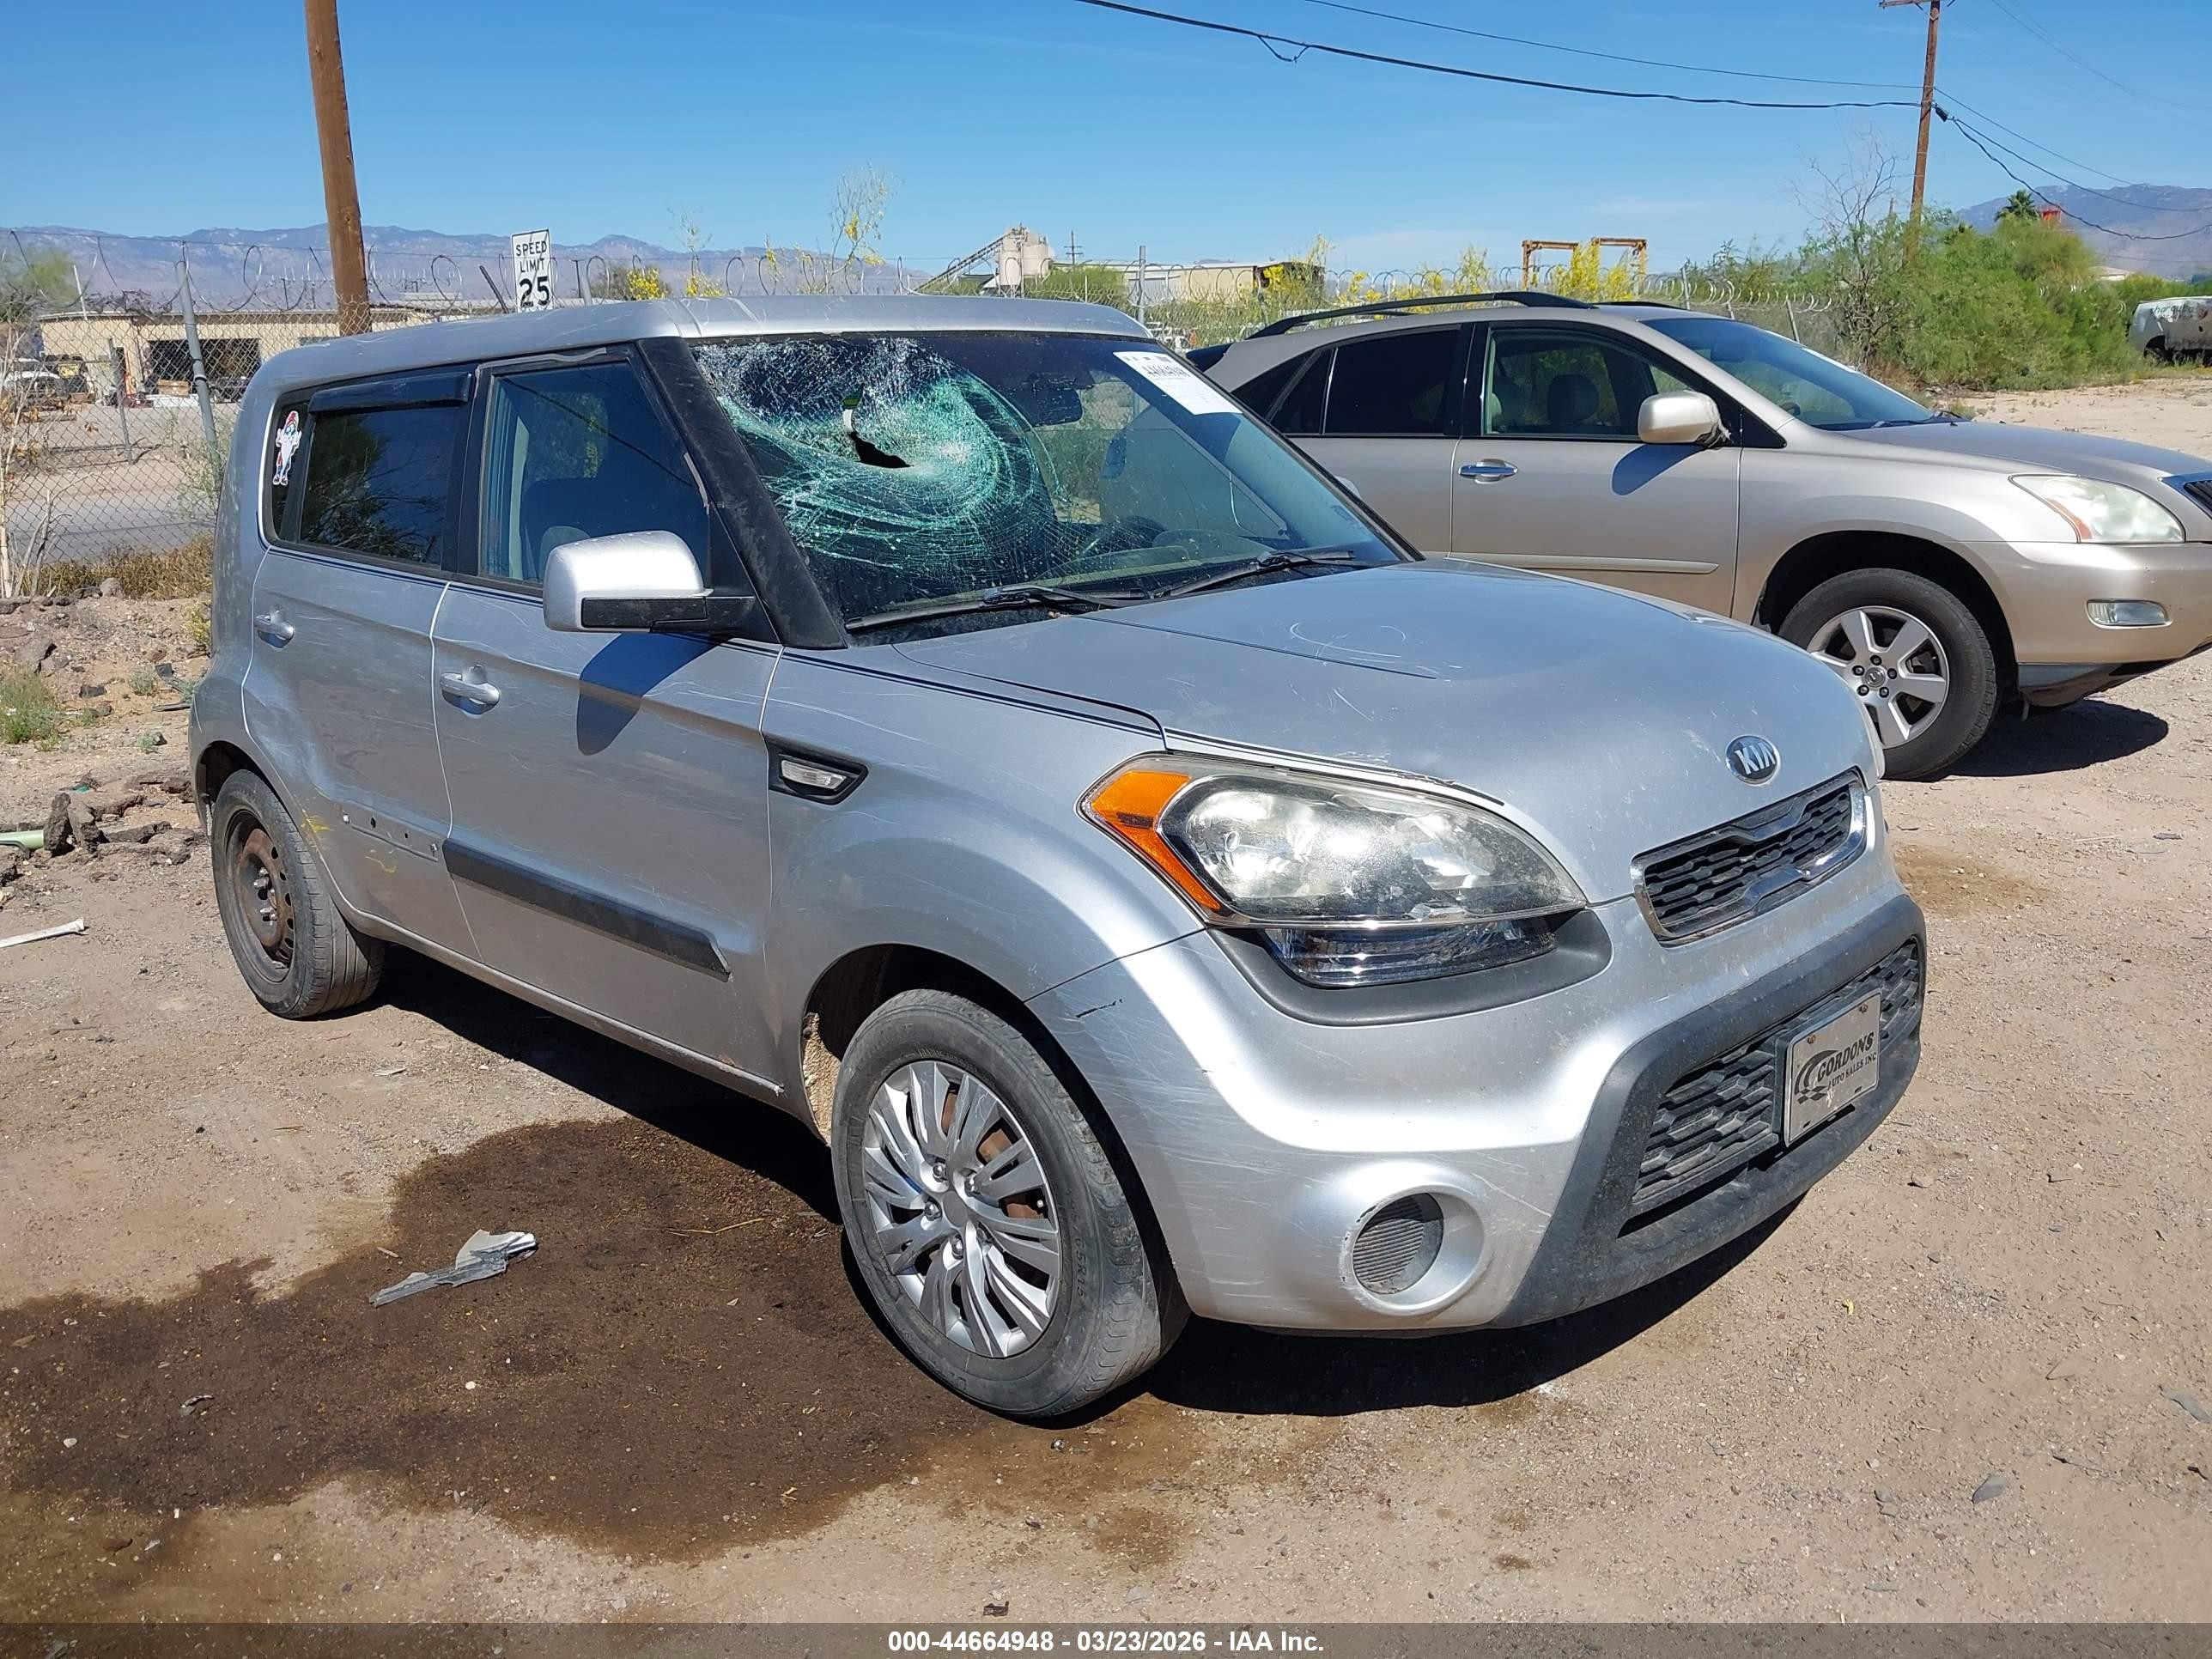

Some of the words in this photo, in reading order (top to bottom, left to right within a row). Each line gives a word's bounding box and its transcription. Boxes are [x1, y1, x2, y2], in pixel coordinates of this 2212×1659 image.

[516, 240, 547, 256] SPEED
[520, 258, 545, 272] LIMIT
[520, 276, 550, 307] 25
[1734, 742, 1776, 775] KIA
[1817, 1032, 1874, 1082] GORDONS
[1827, 1073, 1844, 1091] AUTO
[1845, 1059, 1863, 1078] SALES
[1864, 1052, 1876, 1066] INC
